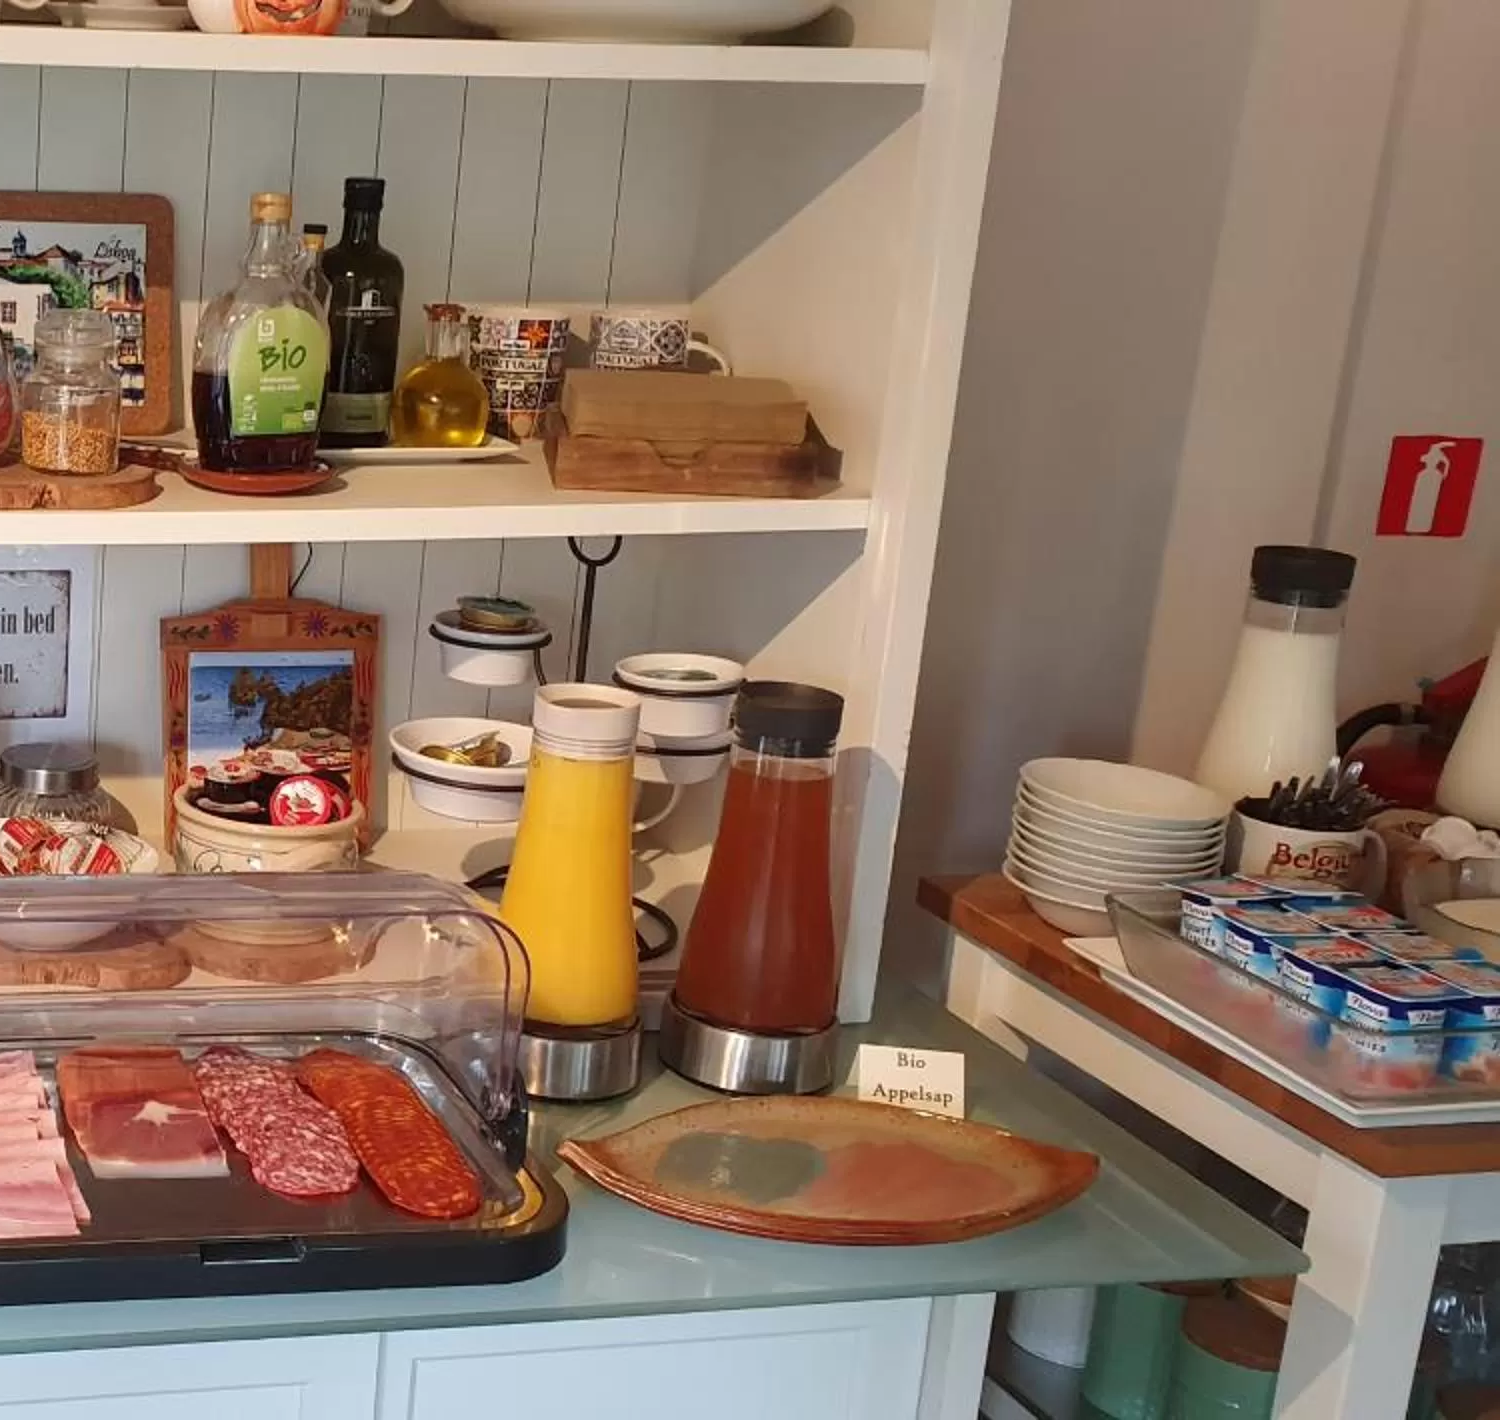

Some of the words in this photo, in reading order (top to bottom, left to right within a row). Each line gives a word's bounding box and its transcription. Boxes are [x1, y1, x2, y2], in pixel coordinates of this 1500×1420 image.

[1, 609, 18, 635] in
[23, 606, 56, 635] bed
[897, 1052, 927, 1069] Bio
[872, 1083, 954, 1108] Appelsap
